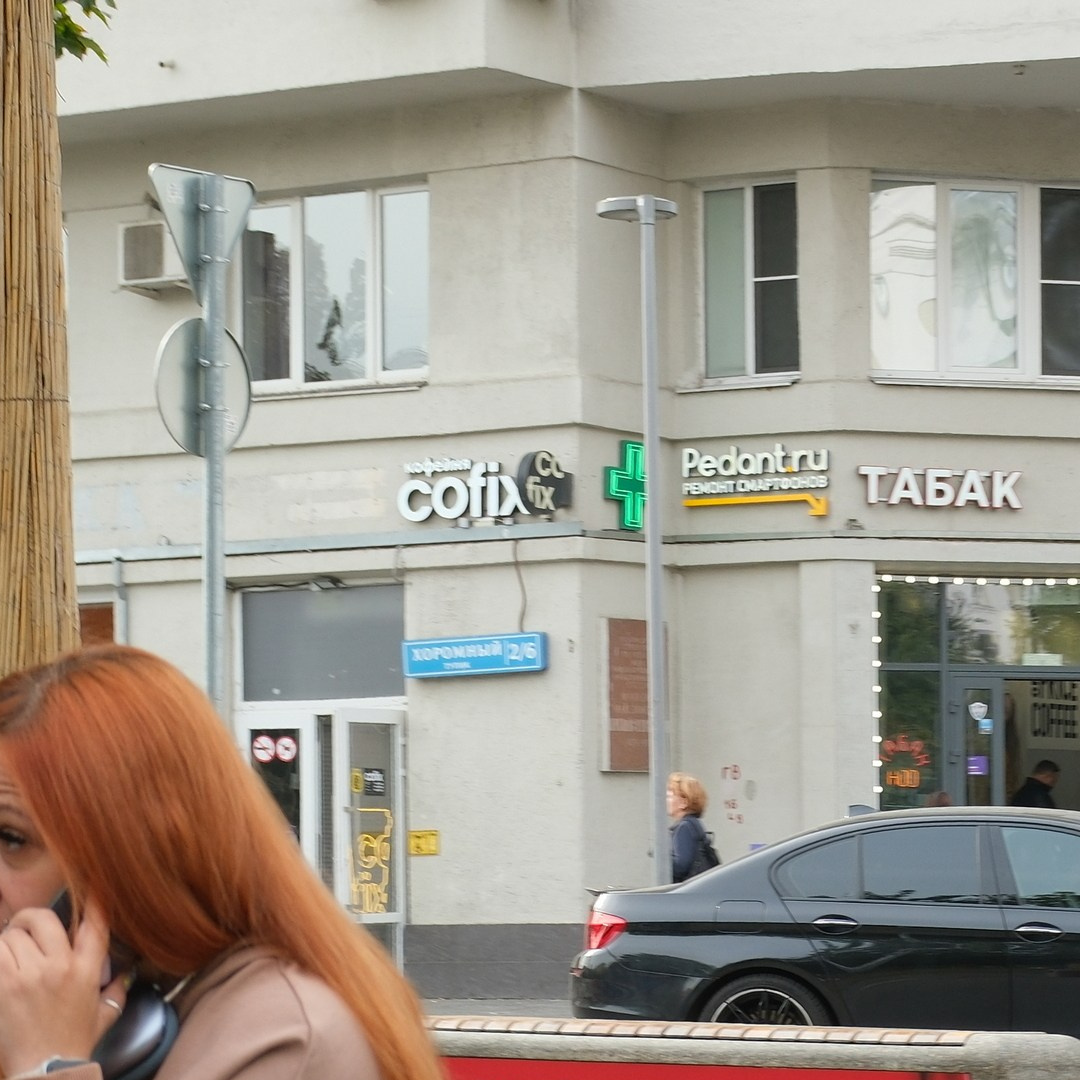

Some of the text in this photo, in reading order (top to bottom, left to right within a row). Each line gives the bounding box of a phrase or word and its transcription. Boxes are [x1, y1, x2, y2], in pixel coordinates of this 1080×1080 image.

[681, 443, 829, 478] Pedant.ru
[397, 461, 531, 523] cofix
[682, 476, 829, 496] РЕМОНТ СМАРТФОНОВ
[857, 465, 1023, 510] ТАБАК
[411, 640, 538, 661] ХОРОМНЫЙ 2/6
